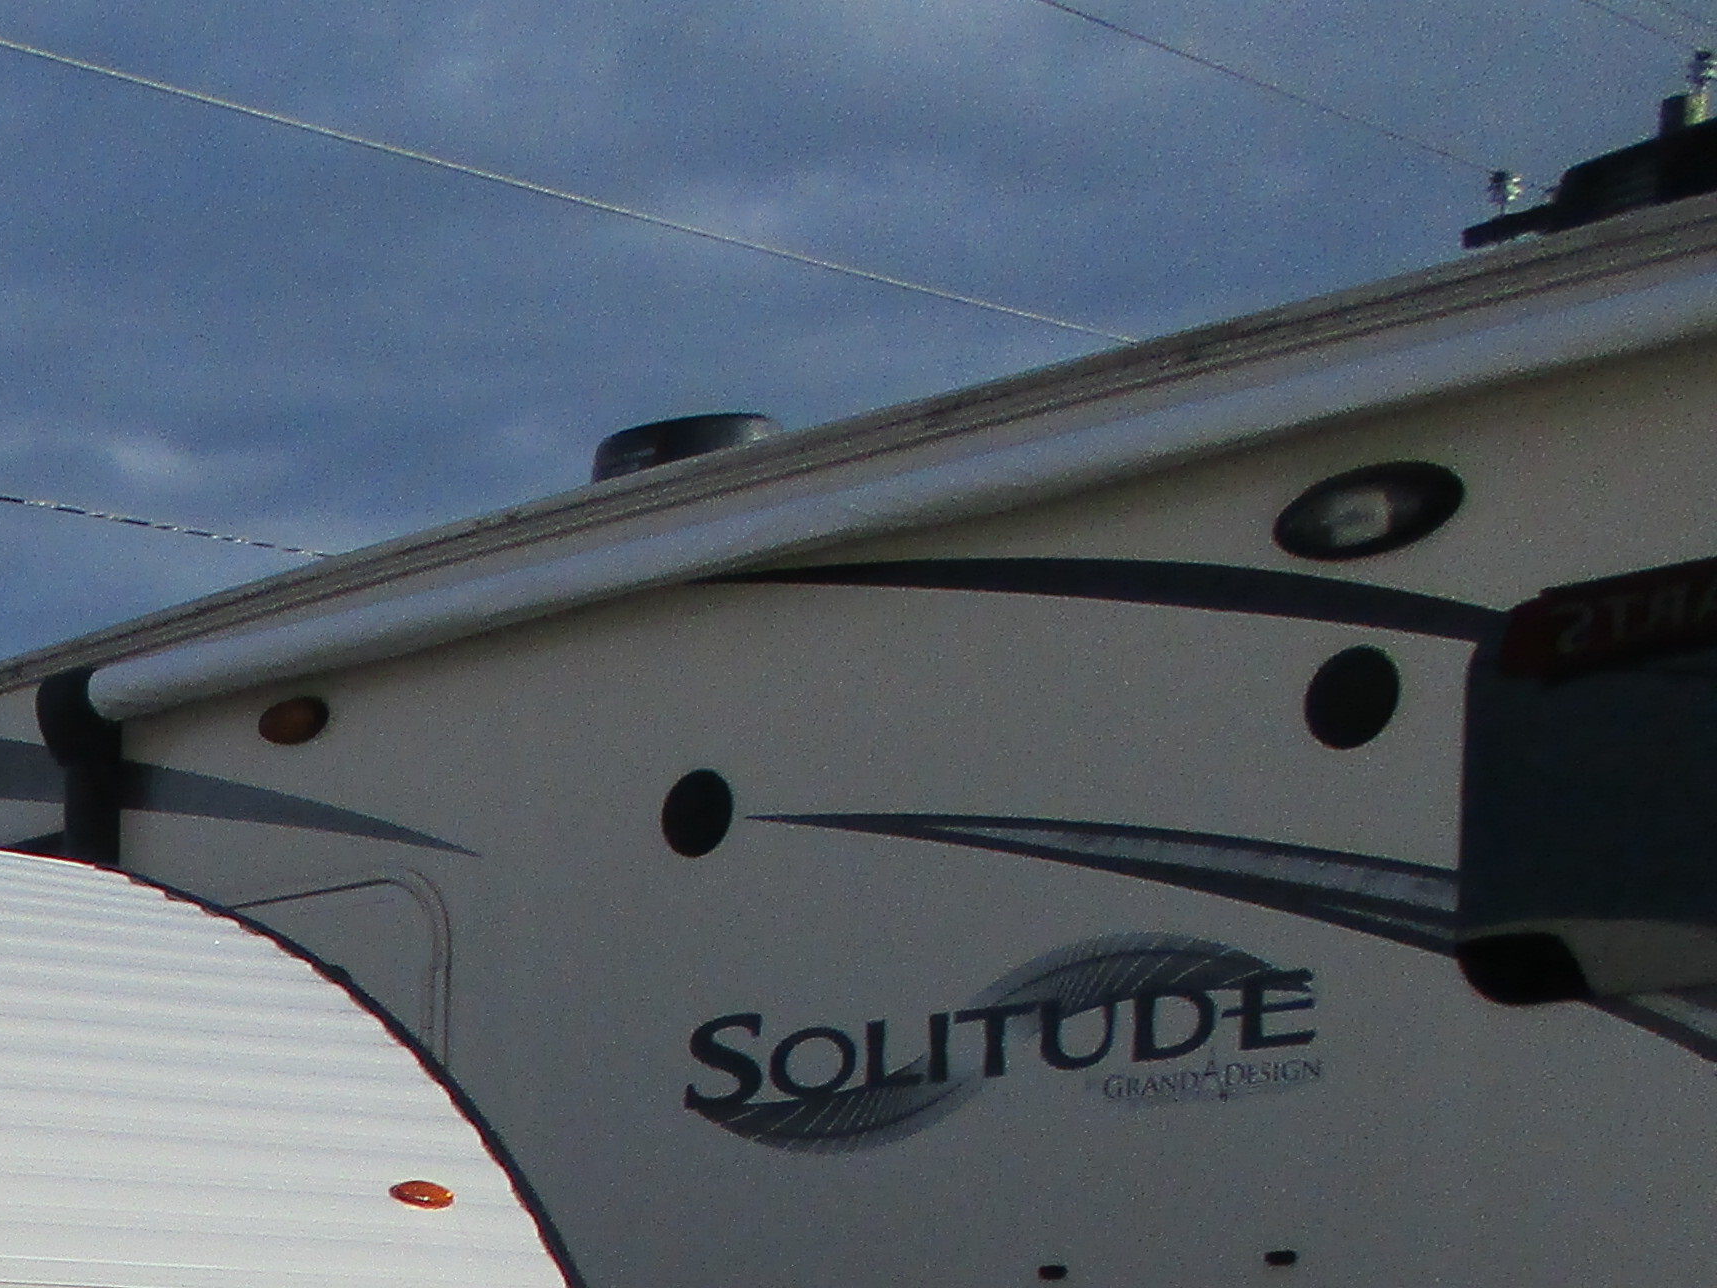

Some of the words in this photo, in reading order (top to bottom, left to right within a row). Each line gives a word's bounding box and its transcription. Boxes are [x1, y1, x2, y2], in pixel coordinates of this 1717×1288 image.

[684, 967, 1319, 1110] SOLITUDE
[1101, 1068, 1203, 1099] GRAND
[1223, 1057, 1322, 1087] DESIGN
